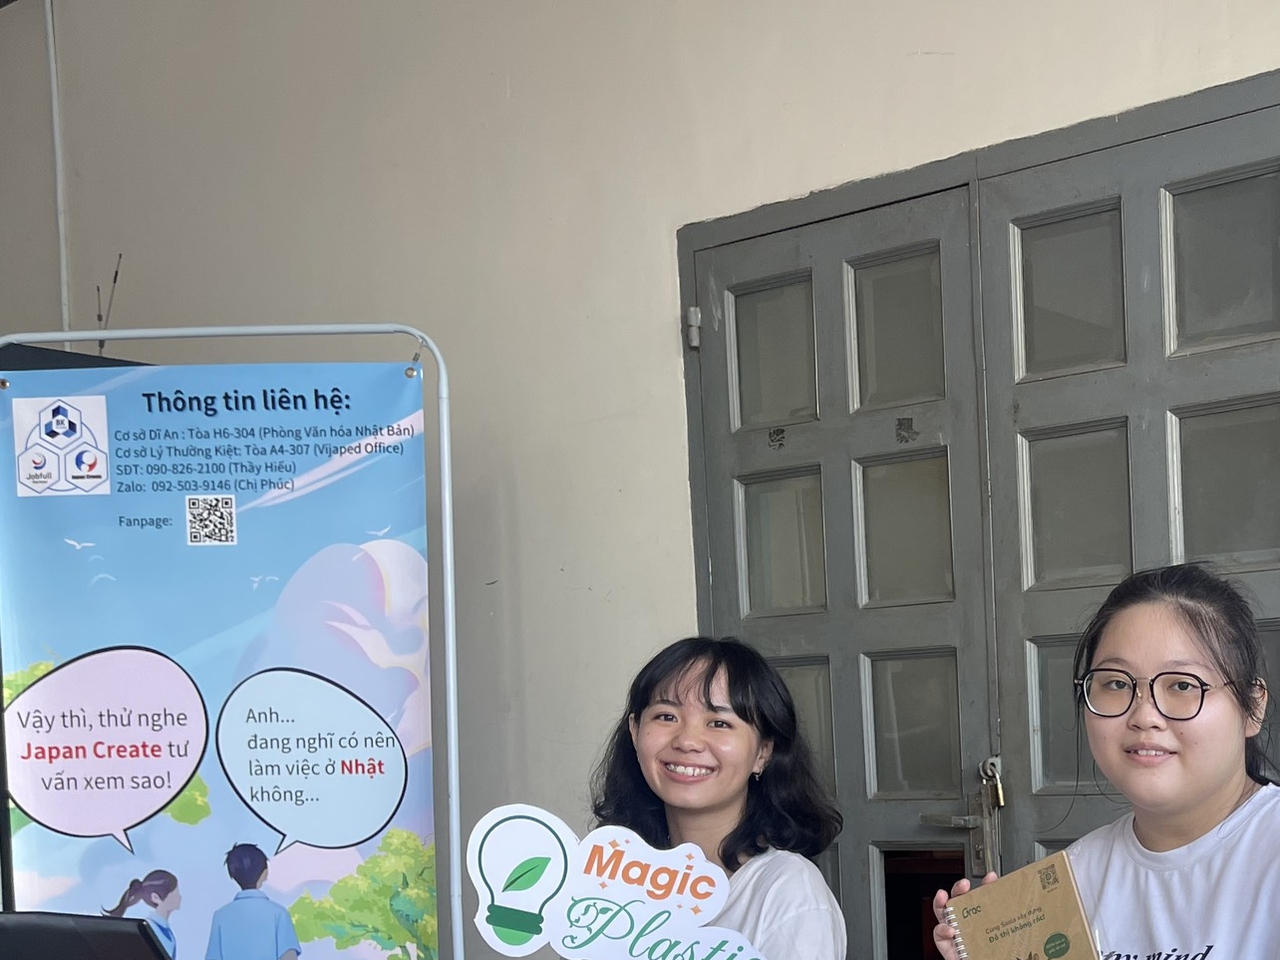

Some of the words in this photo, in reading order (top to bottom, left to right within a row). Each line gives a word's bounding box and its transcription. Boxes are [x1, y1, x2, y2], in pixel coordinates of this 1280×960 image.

[142, 390, 218, 417] Thông
[223, 389, 256, 411] tin
[262, 388, 307, 410] liên
[314, 387, 350, 415] hệ:
[114, 430, 130, 441] Cơ
[149, 428, 161, 440] Dĩ
[164, 429, 179, 440] An
[188, 427, 210, 439] Tòa
[213, 427, 255, 439] H6-304
[259, 426, 302, 441] (Phòng
[304, 426, 327, 438] Văn
[330, 425, 352, 437] hóa
[355, 424, 384, 440] Nhật
[387, 423, 414, 438] Bản)
[115, 447, 131, 459] Cơ
[150, 445, 163, 460] Lý
[166, 445, 212, 460] Thường
[215, 444, 241, 460] Kiệt:
[244, 444, 267, 456] Tòa
[270, 443, 310, 456] A4-307
[313, 442, 361, 458] (Vijaped
[364, 441, 404, 456] Office)
[116, 464, 143, 475] SĐT:
[146, 463, 225, 475] 090-826-2100
[228, 461, 262, 477] (Thầy
[264, 460, 296, 475] Hiếu)
[117, 481, 146, 492] Zalo:
[151, 480, 231, 492] 092-503-9146
[234, 479, 258, 493] (Chị
[260, 478, 294, 492] Phúc)
[119, 516, 174, 530] Fanpage:
[17, 709, 55, 733] Vậy
[61, 708, 93, 731] thì,
[98, 707, 132, 728] thử
[138, 708, 187, 732] nghe
[246, 707, 295, 723] Anh...
[20, 742, 87, 763] Japan
[93, 741, 162, 758] Create
[167, 740, 190, 758] tư
[248, 733, 291, 754] đang
[296, 731, 335, 753] nghĩ
[339, 731, 358, 748] có
[364, 731, 396, 748] nên
[249, 759, 280, 776] làm
[286, 758, 320, 780] việc
[325, 758, 336, 776] ở
[341, 757, 385, 779] Nhật
[41, 769, 77, 790] vấn
[83, 774, 124, 790] xem
[131, 771, 171, 789] sao!
[250, 785, 319, 806] không...
[583, 843, 716, 900] Magic
